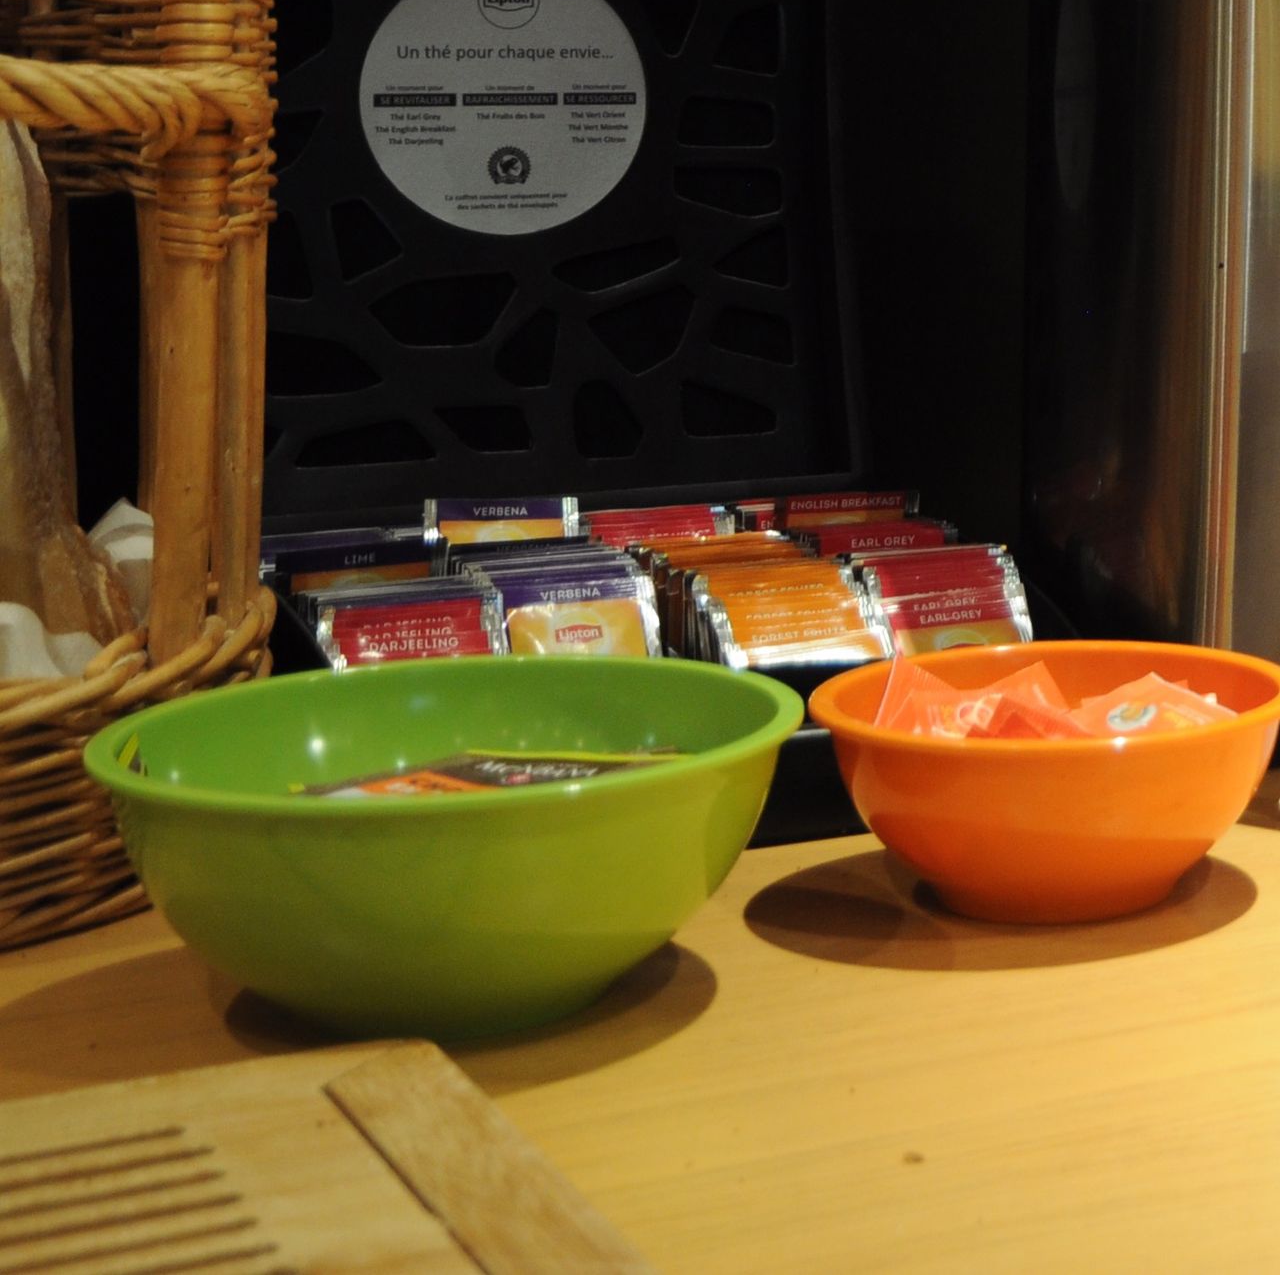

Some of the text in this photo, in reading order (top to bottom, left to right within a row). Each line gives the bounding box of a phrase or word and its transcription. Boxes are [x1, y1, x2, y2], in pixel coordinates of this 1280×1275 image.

[396, 44, 614, 62] Un thé pour chaque envie...
[380, 95, 450, 105] SE REVITALISER
[566, 94, 635, 104] SE RESSOURCER
[423, 113, 440, 123] Grey
[391, 125, 418, 134] English
[791, 496, 901, 510] ENGLISH BREAKFAST
[472, 506, 528, 517] VERBENA
[851, 535, 915, 549] EARL GREY
[344, 553, 375, 565] LIME
[540, 587, 601, 601] VERBENA
[920, 609, 982, 624] EARL GREY
[557, 626, 600, 642] Lipton
[369, 636, 459, 653] DARJEELING
